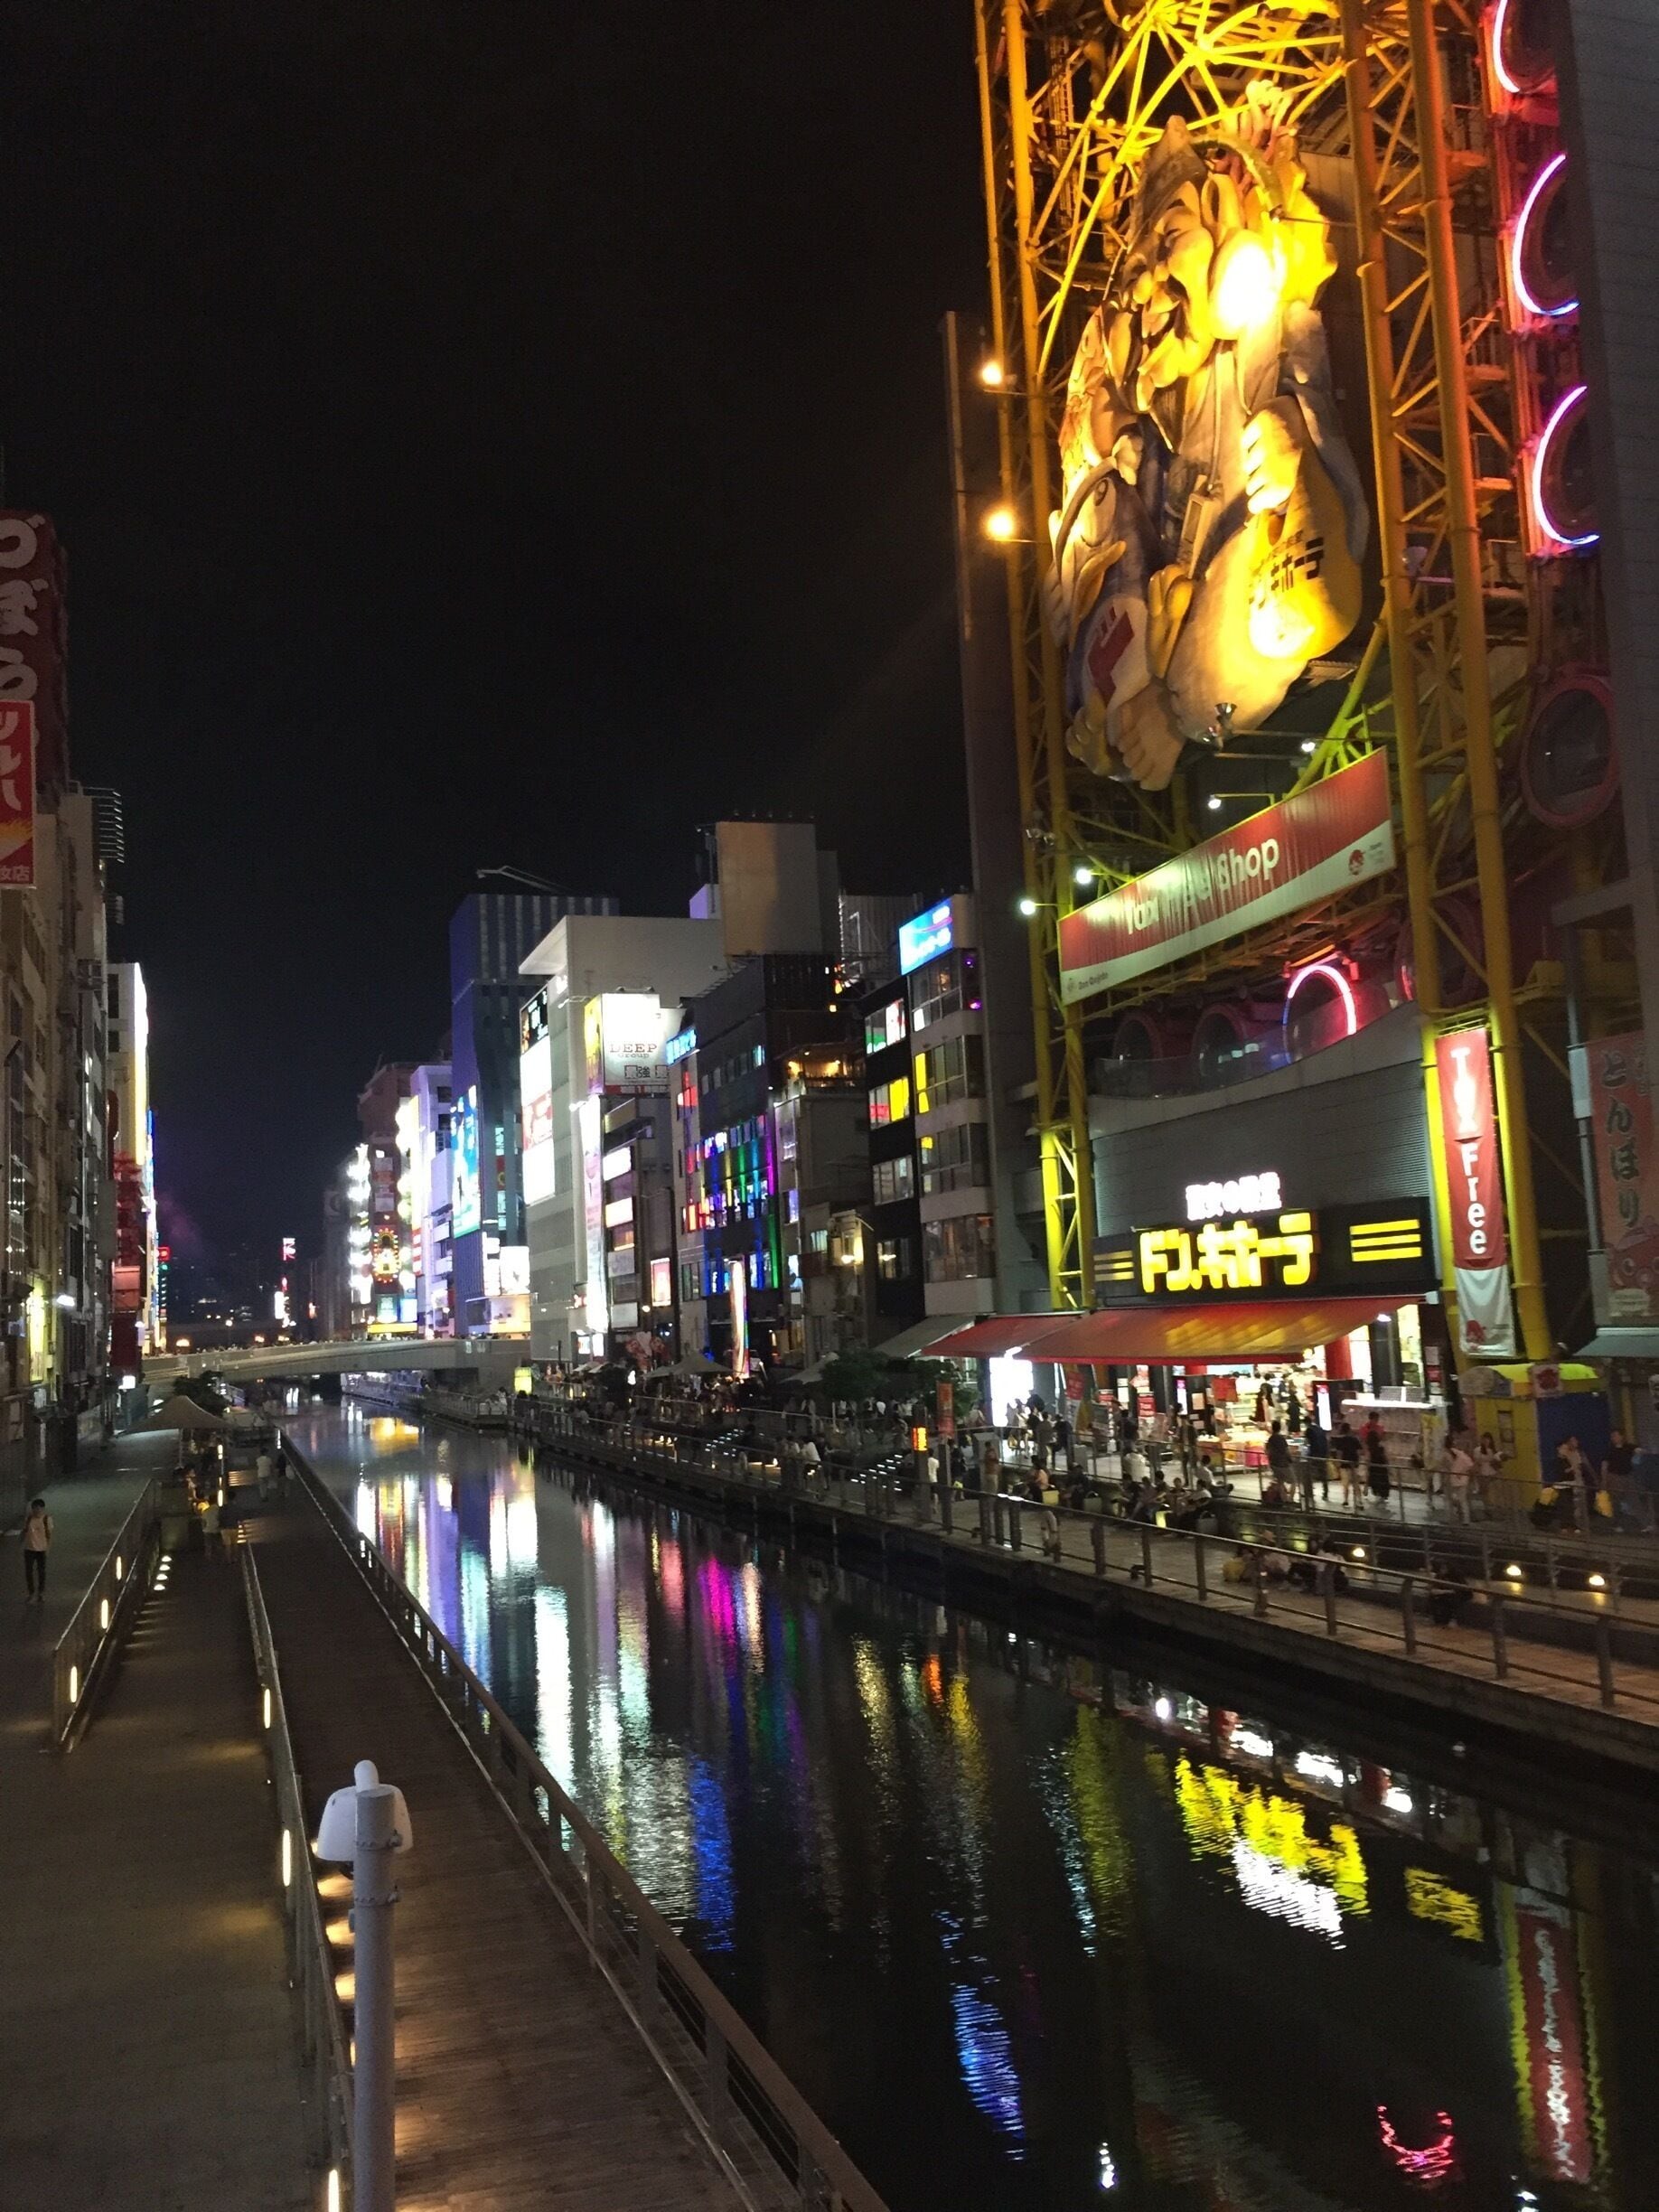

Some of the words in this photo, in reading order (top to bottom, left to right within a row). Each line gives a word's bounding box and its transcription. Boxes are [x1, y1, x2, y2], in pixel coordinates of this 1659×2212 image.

[1217, 839, 1279, 890] Shop
[609, 1043, 658, 1054] DEEP
[1460, 1143, 1486, 1255] Free
